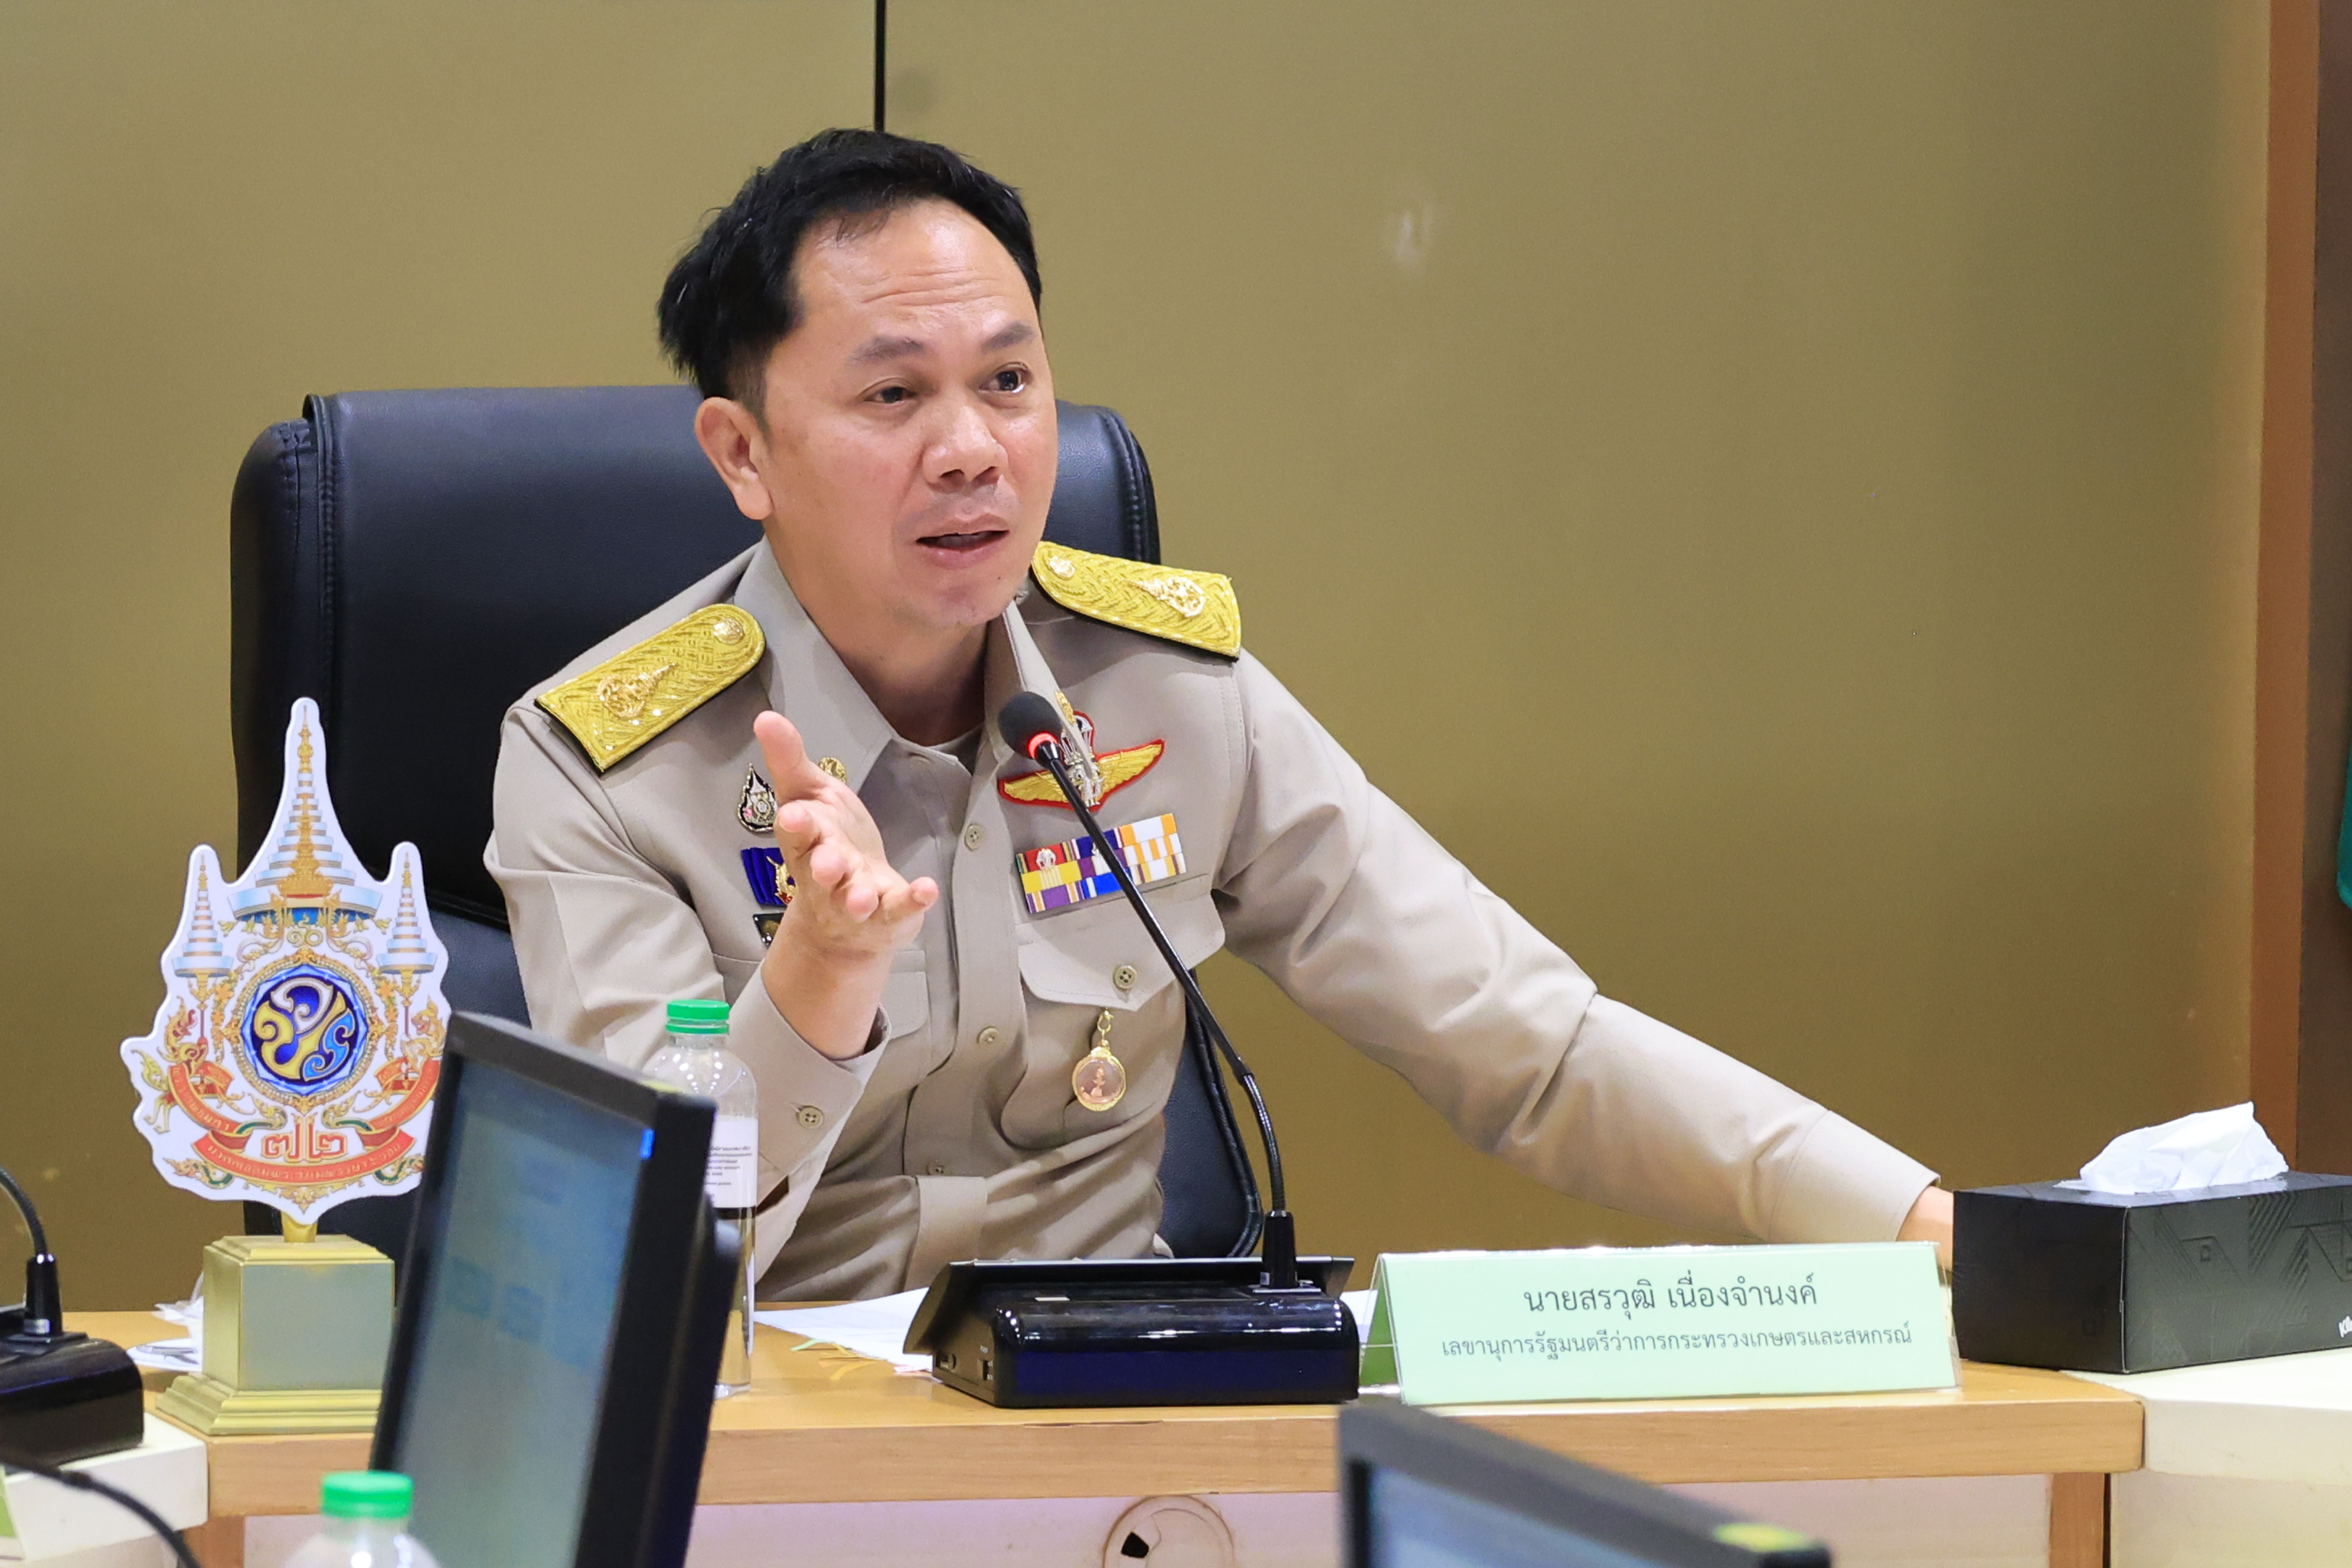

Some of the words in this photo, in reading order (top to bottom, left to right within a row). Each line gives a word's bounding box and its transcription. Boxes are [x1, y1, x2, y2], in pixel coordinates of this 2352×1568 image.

[1524, 1278, 1655, 1320] นายสรวุฒิ
[1668, 1269, 1817, 1308] เนื่องจำนงค์
[1442, 1321, 1912, 1362] เลขานุการรัฐมนตรีว่าการกระทรวงเกษตรและสหกรณ์
